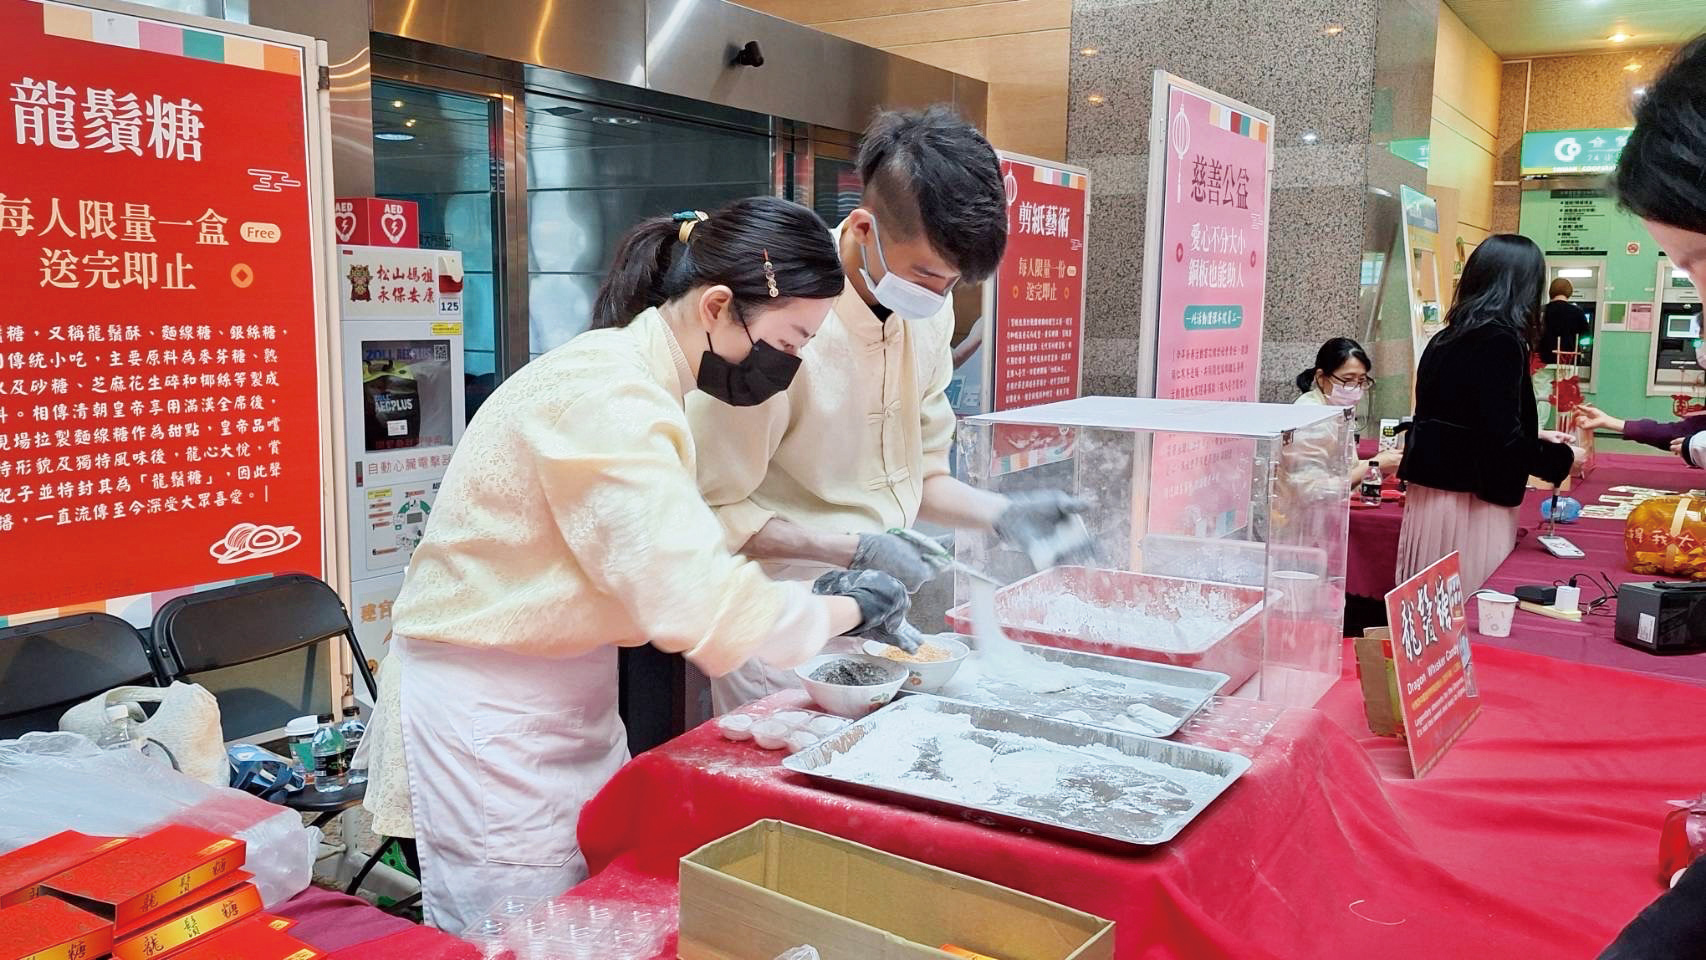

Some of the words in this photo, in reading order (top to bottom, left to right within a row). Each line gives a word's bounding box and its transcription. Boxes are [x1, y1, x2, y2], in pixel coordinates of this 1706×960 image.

[10, 77, 204, 162] 龍鬚糖
[1191, 154, 1250, 211] 慈善公益
[0, 193, 230, 246] 每人限量一盒
[246, 226, 275, 240] Free
[384, 204, 403, 215] AED
[1018, 201, 1071, 238] 剪紙藝術
[1190, 222, 1246, 256] 愛心不分大小
[39, 247, 197, 290] 送完即止
[377, 263, 435, 284] 松山媽祖
[1188, 257, 1244, 290] 銅板也能助人
[377, 286, 435, 304] 永保安康
[1025, 282, 1057, 301] 送完即止
[441, 302, 459, 312] 125
[0, 323, 288, 343] 糖，又稱龍鬚酥、麵線糖、銀絲糖，
[1407, 673, 1426, 695] Dragon
